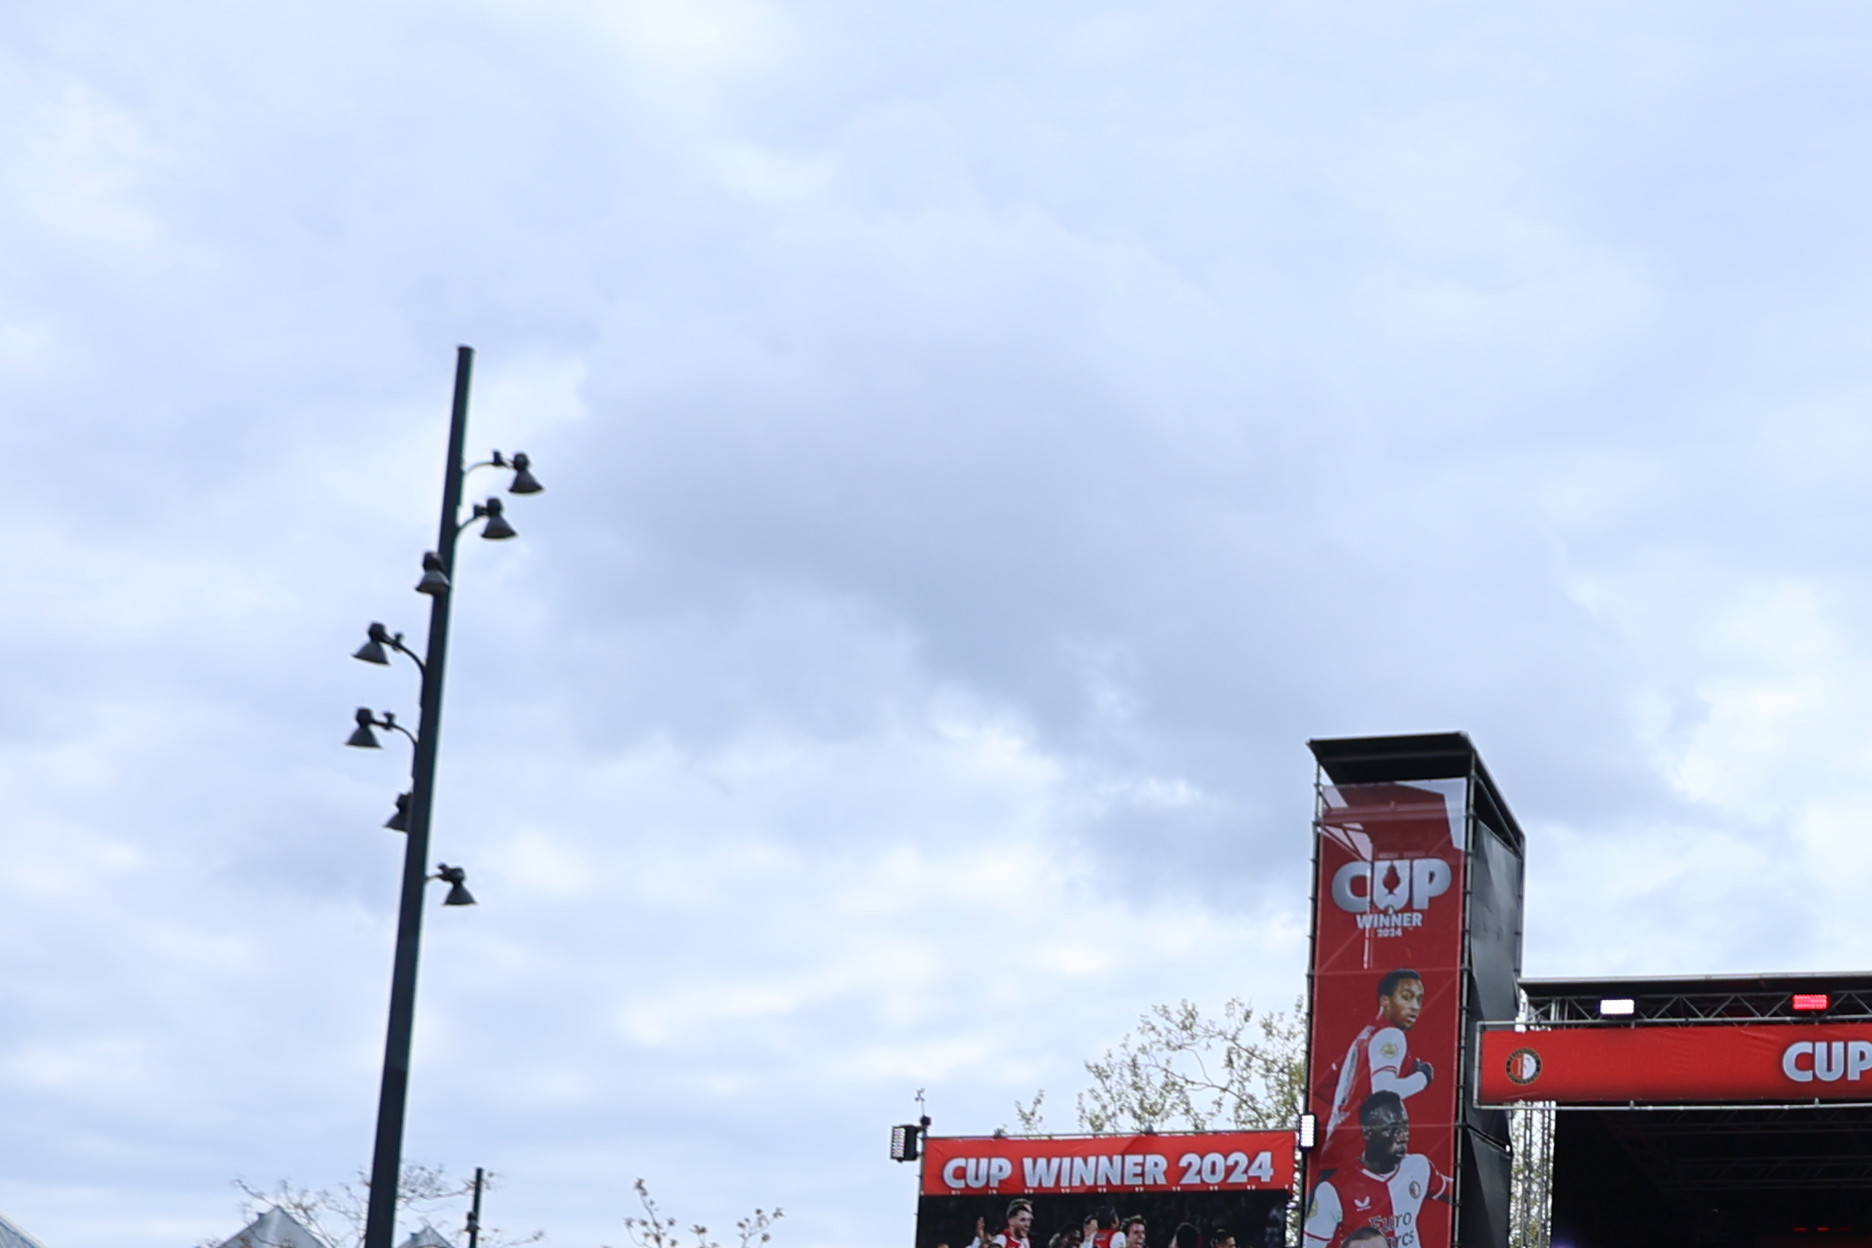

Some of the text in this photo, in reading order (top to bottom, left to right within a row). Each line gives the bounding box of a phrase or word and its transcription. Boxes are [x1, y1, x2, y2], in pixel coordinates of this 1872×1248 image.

[1331, 858, 1452, 913] CUP
[1355, 912, 1423, 929] WINNER
[1377, 928, 1402, 938] 2024
[942, 1151, 1275, 1189] CUP WINNER 2024
